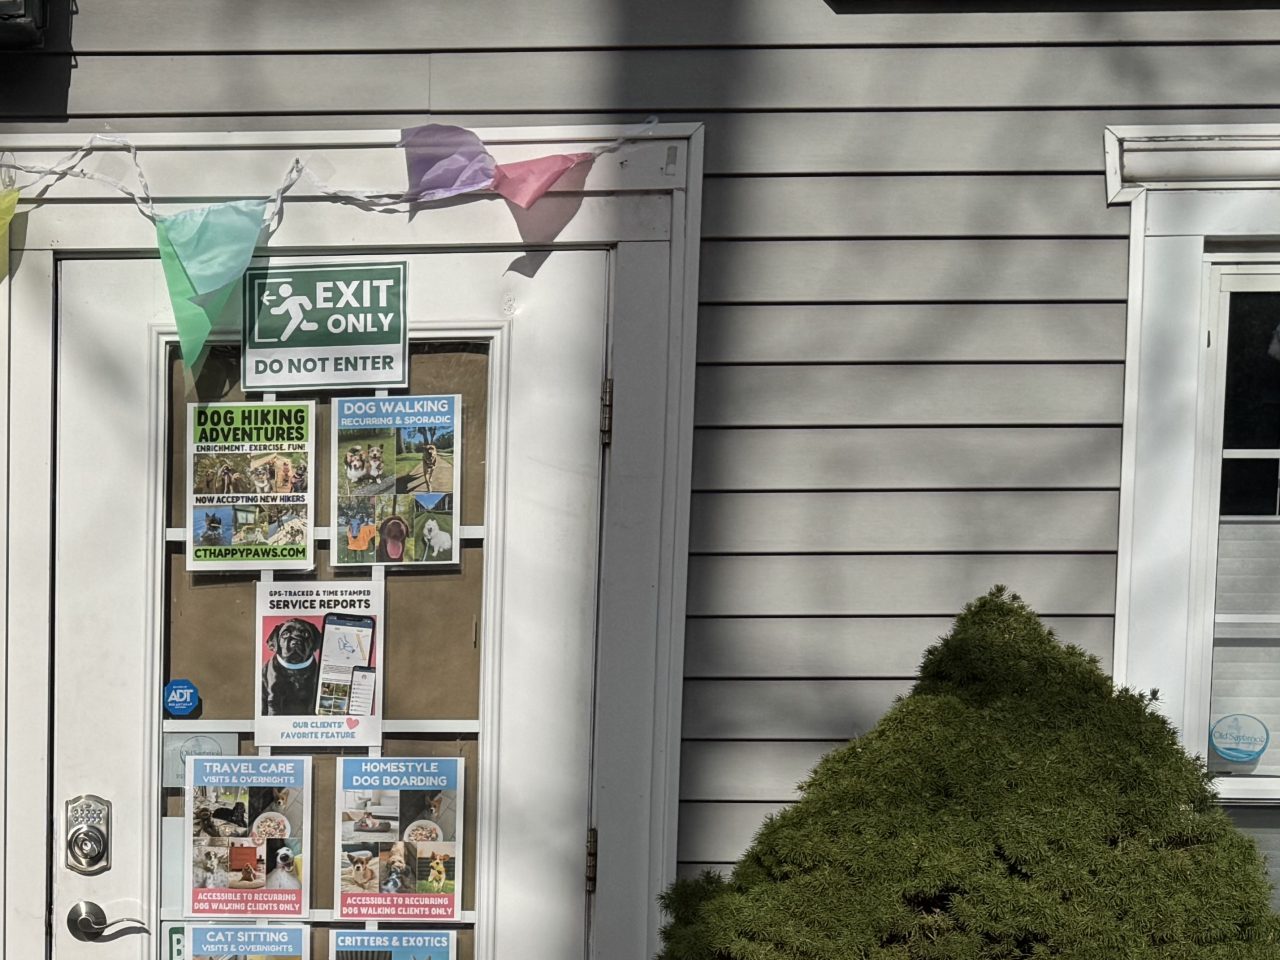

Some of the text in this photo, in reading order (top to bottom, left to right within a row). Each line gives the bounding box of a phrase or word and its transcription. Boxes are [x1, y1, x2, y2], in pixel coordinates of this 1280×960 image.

[316, 279, 394, 308] EXIT
[327, 313, 394, 333] ONLY
[255, 355, 394, 375] DO NOT ENTER
[344, 400, 448, 414] DOG WALKING
[197, 409, 304, 426] DOG HIKING
[342, 417, 392, 426] RECURRING
[404, 416, 450, 424] SPORADIC
[199, 426, 304, 442] ADVENTURES
[196, 496, 215, 504] NOW
[216, 496, 258, 504] ACCEPTING
[194, 548, 306, 558] CTHAPPYPAWS.COM
[269, 599, 371, 609] SERVICE REPORTS
[168, 690, 194, 702] ADT
[204, 762, 294, 773] TRAVEL CARE
[362, 762, 438, 772] HOMESTYLE
[240, 776, 294, 784] OVERNIGHTS
[352, 776, 447, 786] DOG BOARDING
[346, 896, 391, 904] ACCESSIBLE
[206, 932, 288, 942] CAT SITTING
[338, 936, 448, 947] CRITTERS & EXOTICS
[202, 944, 228, 952] VISITS
